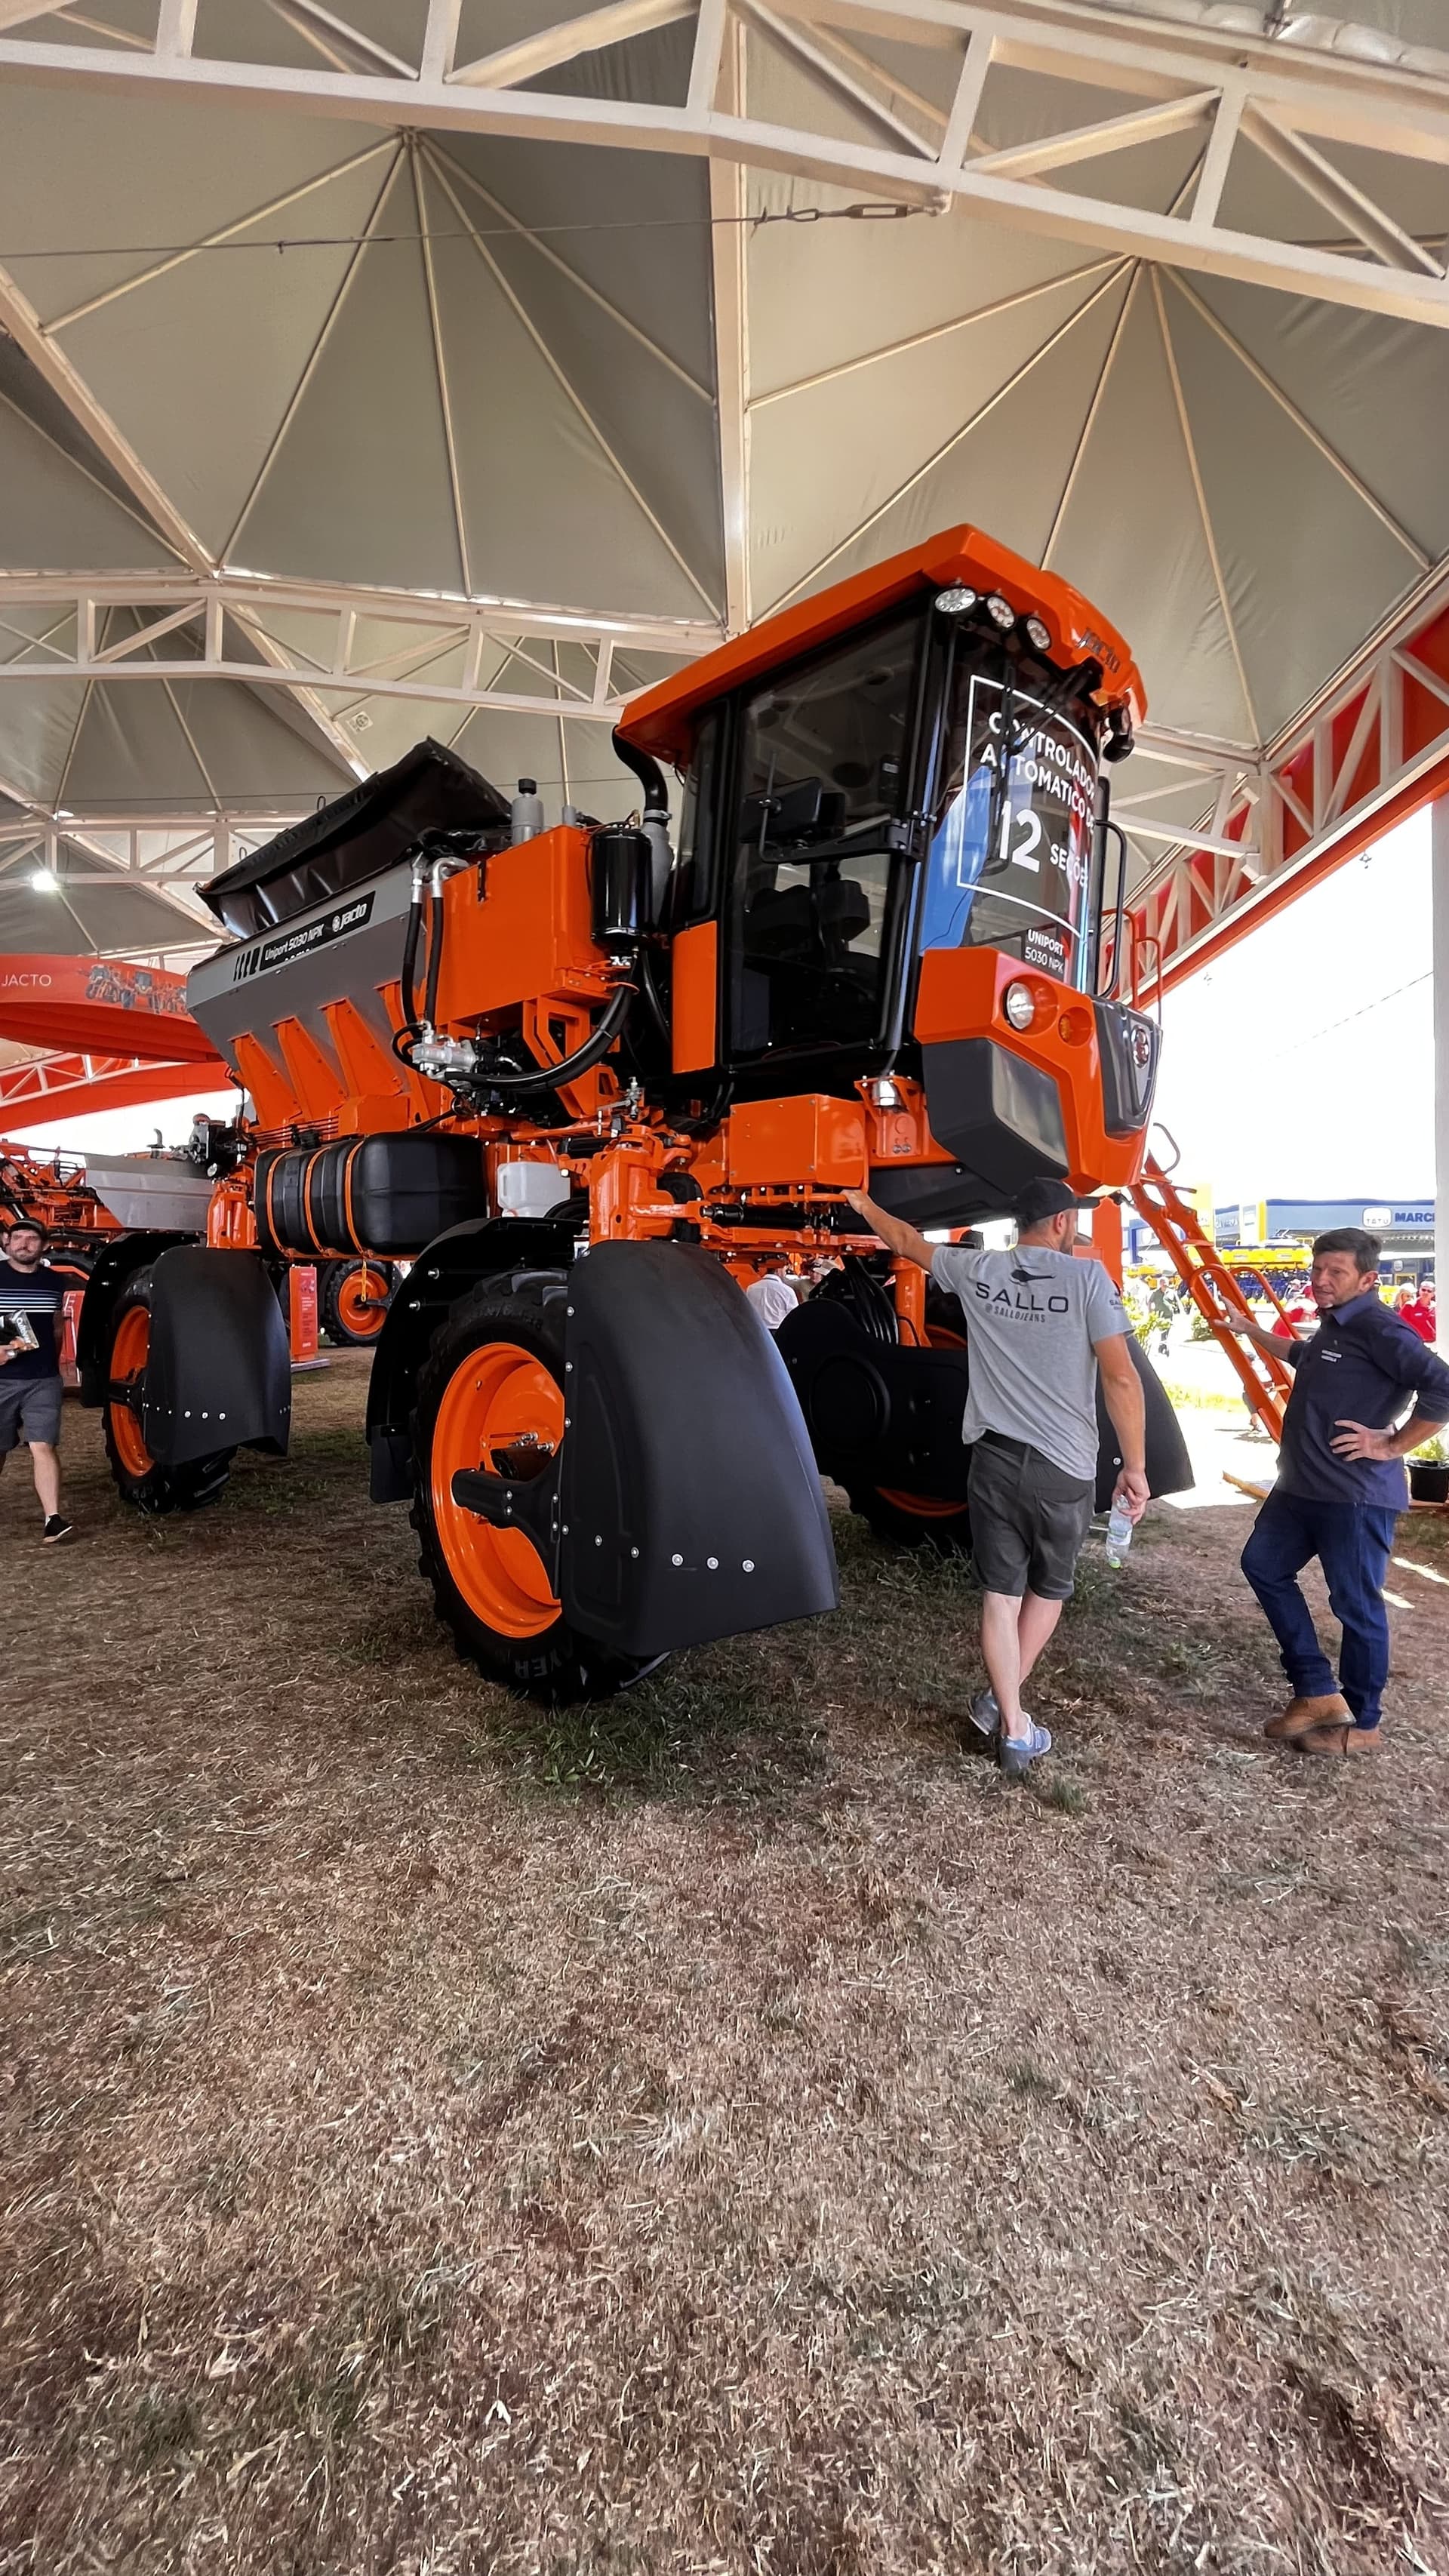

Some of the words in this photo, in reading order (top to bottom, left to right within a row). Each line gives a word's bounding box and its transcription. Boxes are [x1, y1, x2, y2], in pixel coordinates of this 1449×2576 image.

[989, 712, 1095, 799] CNTROLADO
[980, 743, 1085, 818] ATOMATICO
[999, 800, 1041, 873] 12
[288, 931, 308, 951] 5030
[339, 903, 367, 930] jacto
[1025, 946, 1048, 965] 5030
[1028, 928, 1064, 956] UNIPORT
[1048, 956, 1064, 974] NPK
[2, 974, 52, 987] JACTO
[1394, 1212, 1435, 1223] MARC
[975, 1282, 1069, 1313] SALLO
